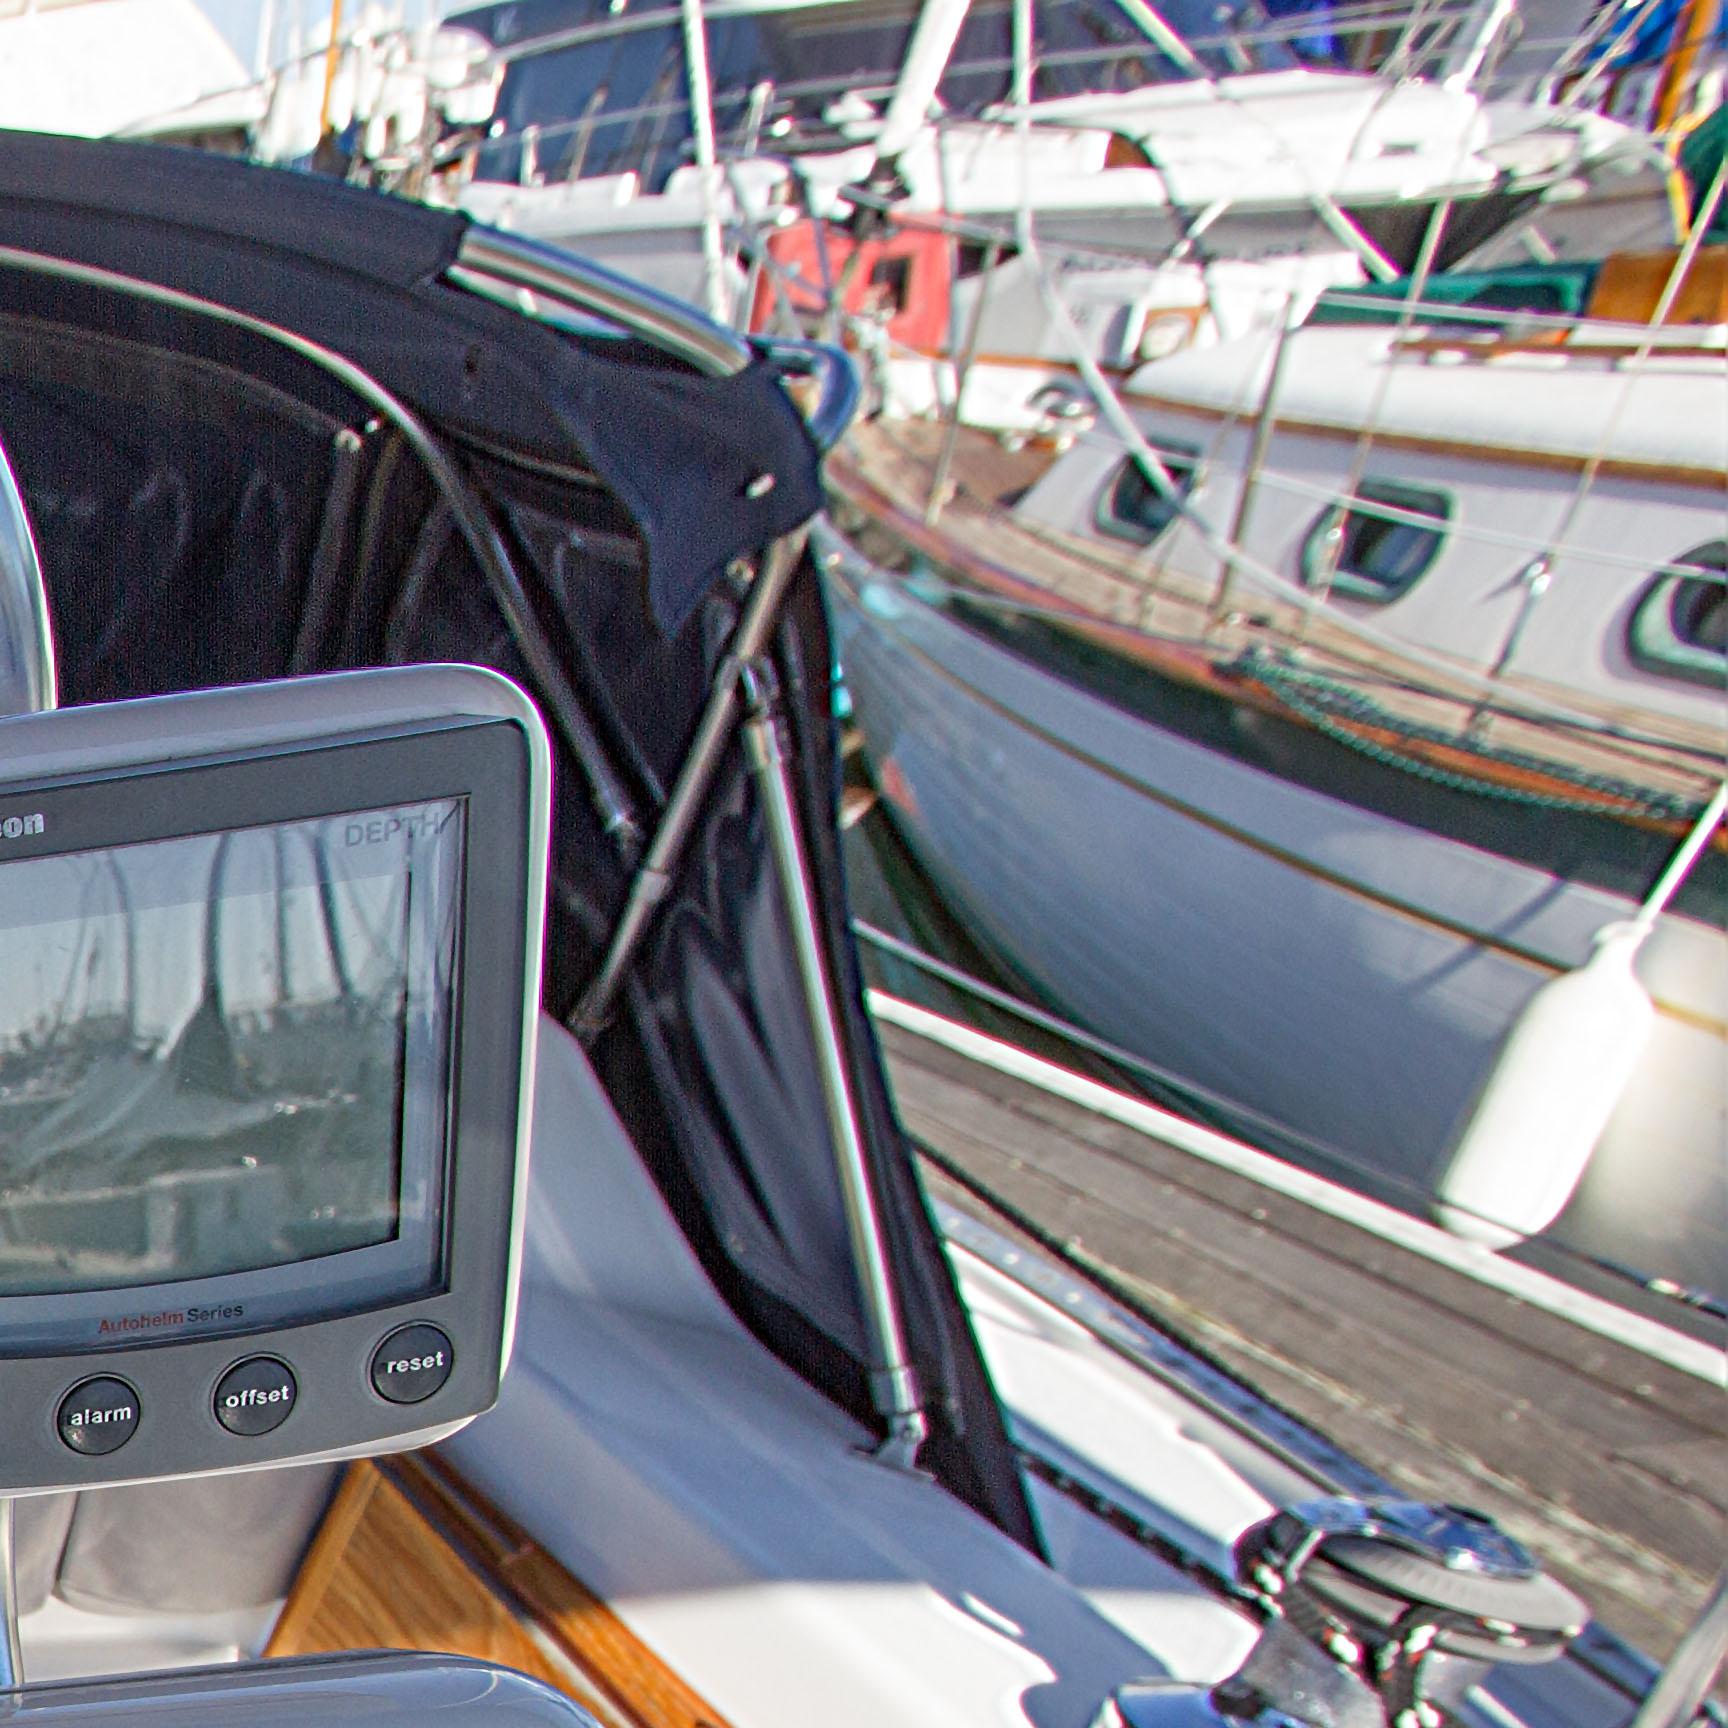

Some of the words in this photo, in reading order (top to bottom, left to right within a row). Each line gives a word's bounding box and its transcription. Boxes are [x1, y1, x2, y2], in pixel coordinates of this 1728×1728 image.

[345, 811, 440, 848] DEPTH
[97, 1311, 185, 1334] Autohelm
[187, 1303, 244, 1323] Series
[386, 1350, 444, 1375] reset
[224, 1384, 290, 1410] offset
[70, 1404, 132, 1427] alarm
